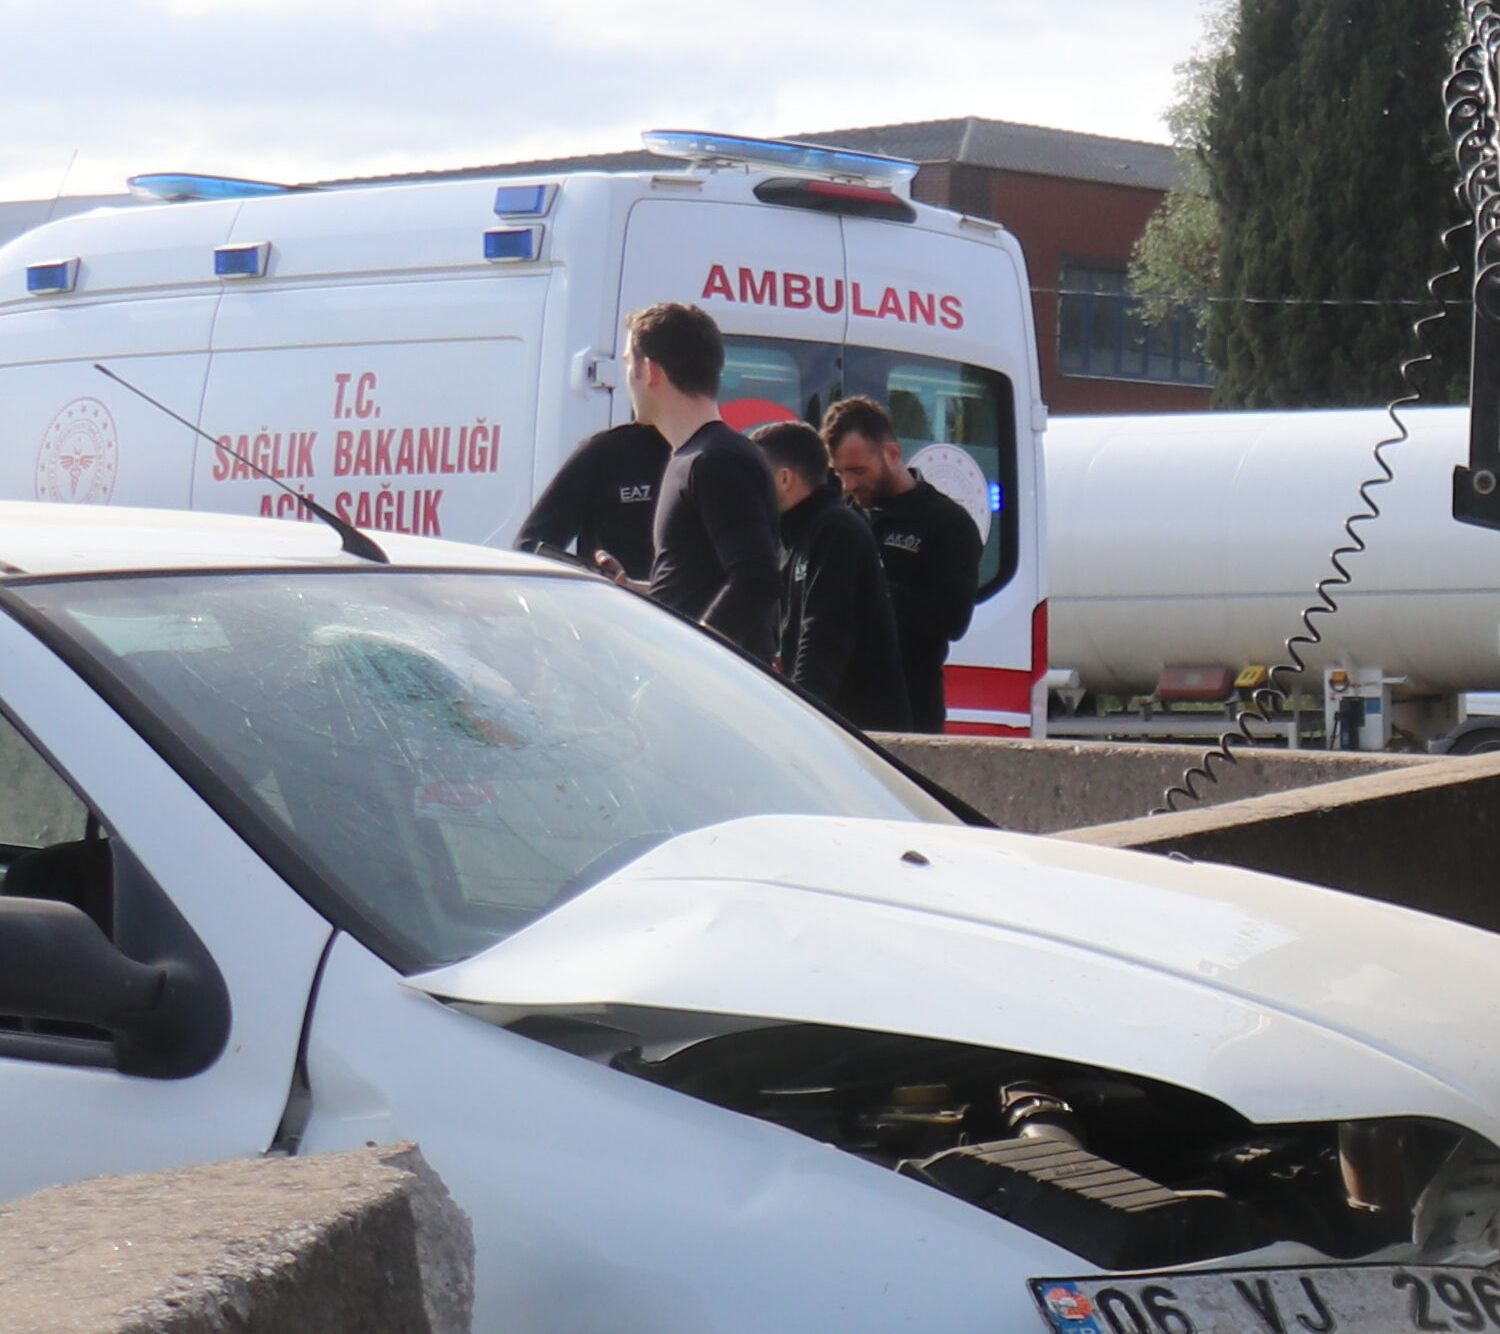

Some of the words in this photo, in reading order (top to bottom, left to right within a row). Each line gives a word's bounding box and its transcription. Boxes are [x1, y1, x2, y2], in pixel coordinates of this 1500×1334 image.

[701, 263, 965, 331] AMBULANS
[333, 371, 382, 419] T.C.
[212, 425, 318, 482] SAĞLIK
[333, 417, 502, 478] BAKANLIĞI
[335, 481, 444, 537] SAĞLIK
[620, 485, 651, 501] EA7
